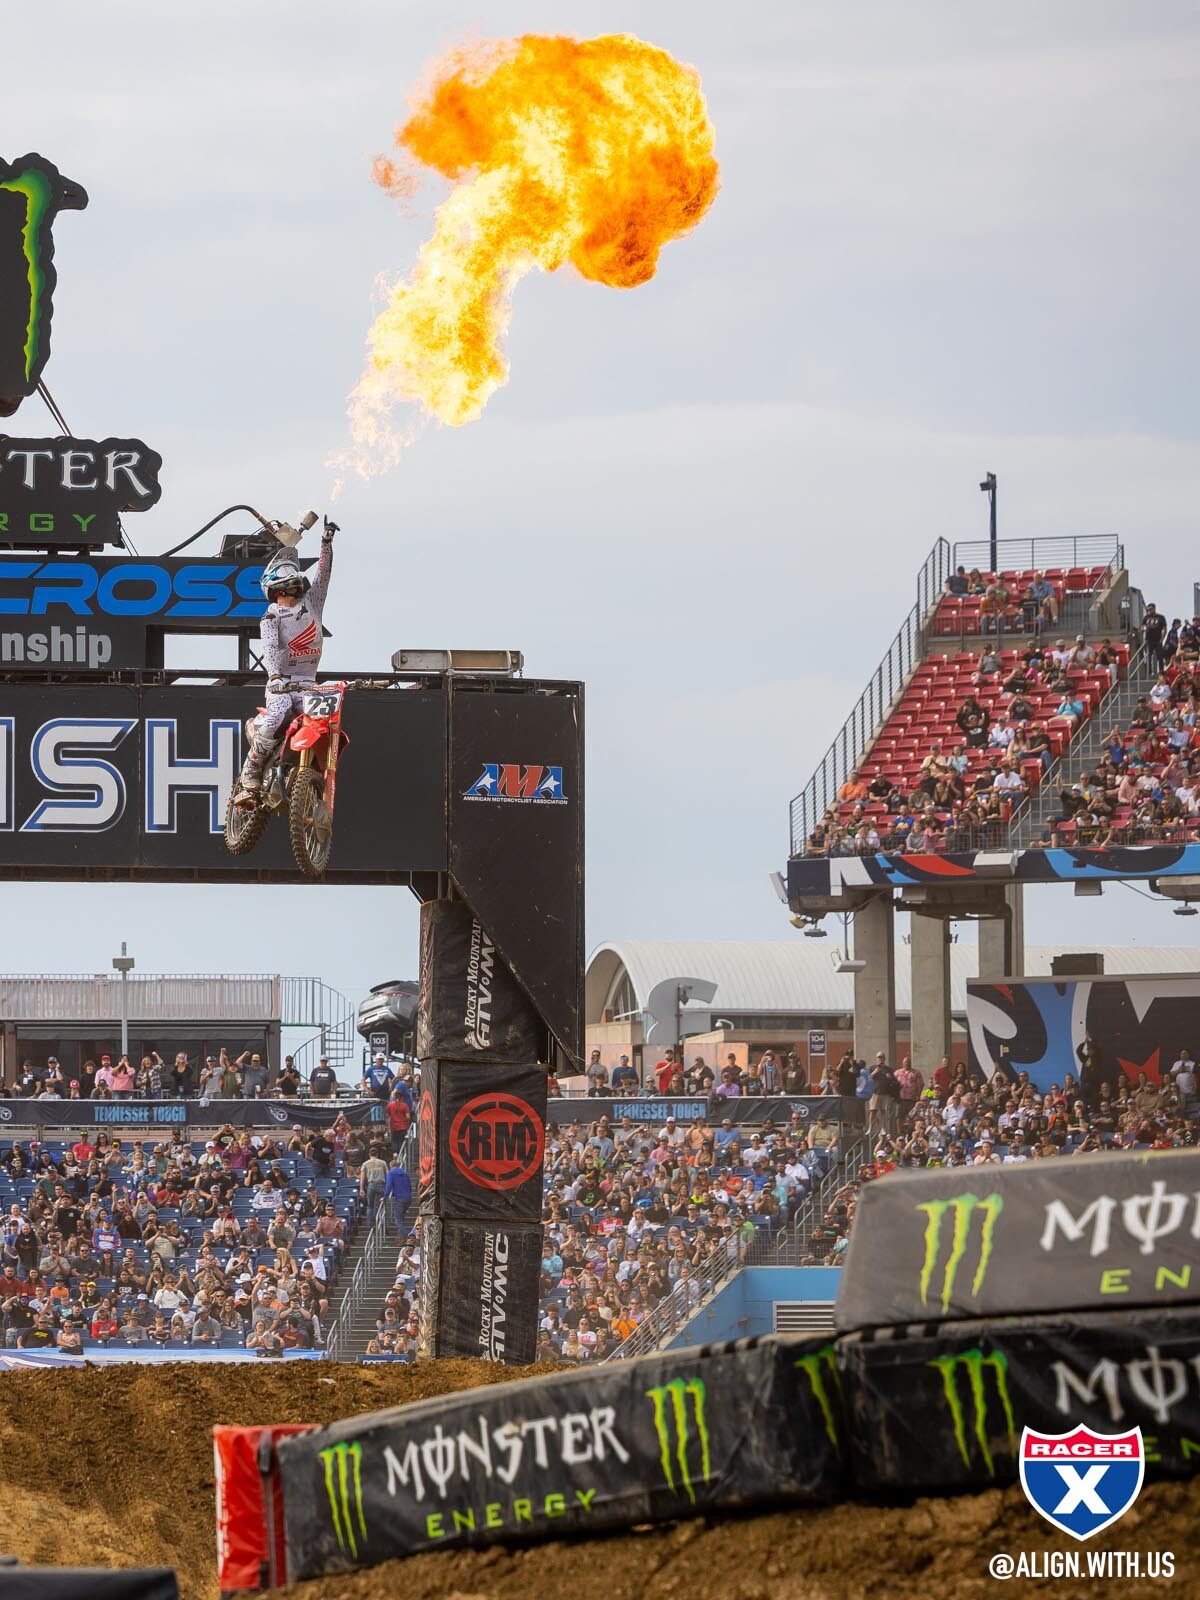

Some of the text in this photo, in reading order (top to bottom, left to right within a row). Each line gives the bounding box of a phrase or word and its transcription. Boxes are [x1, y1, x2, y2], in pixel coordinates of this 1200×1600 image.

[308, 696, 338, 717] 23
[462, 763, 568, 800] AMA
[464, 985, 478, 1028] ROCKY
[372, 1037, 387, 1045] 103
[93, 1105, 186, 1122] TENNESSEE TOUGH
[613, 1102, 707, 1120] TENNESSEE TOUGH
[469, 1121, 527, 1161] RM
[479, 1231, 495, 1347] ROCKY MOUNTAIN
[383, 1406, 630, 1501] MONSTER
[425, 1487, 597, 1539] ENERGY
